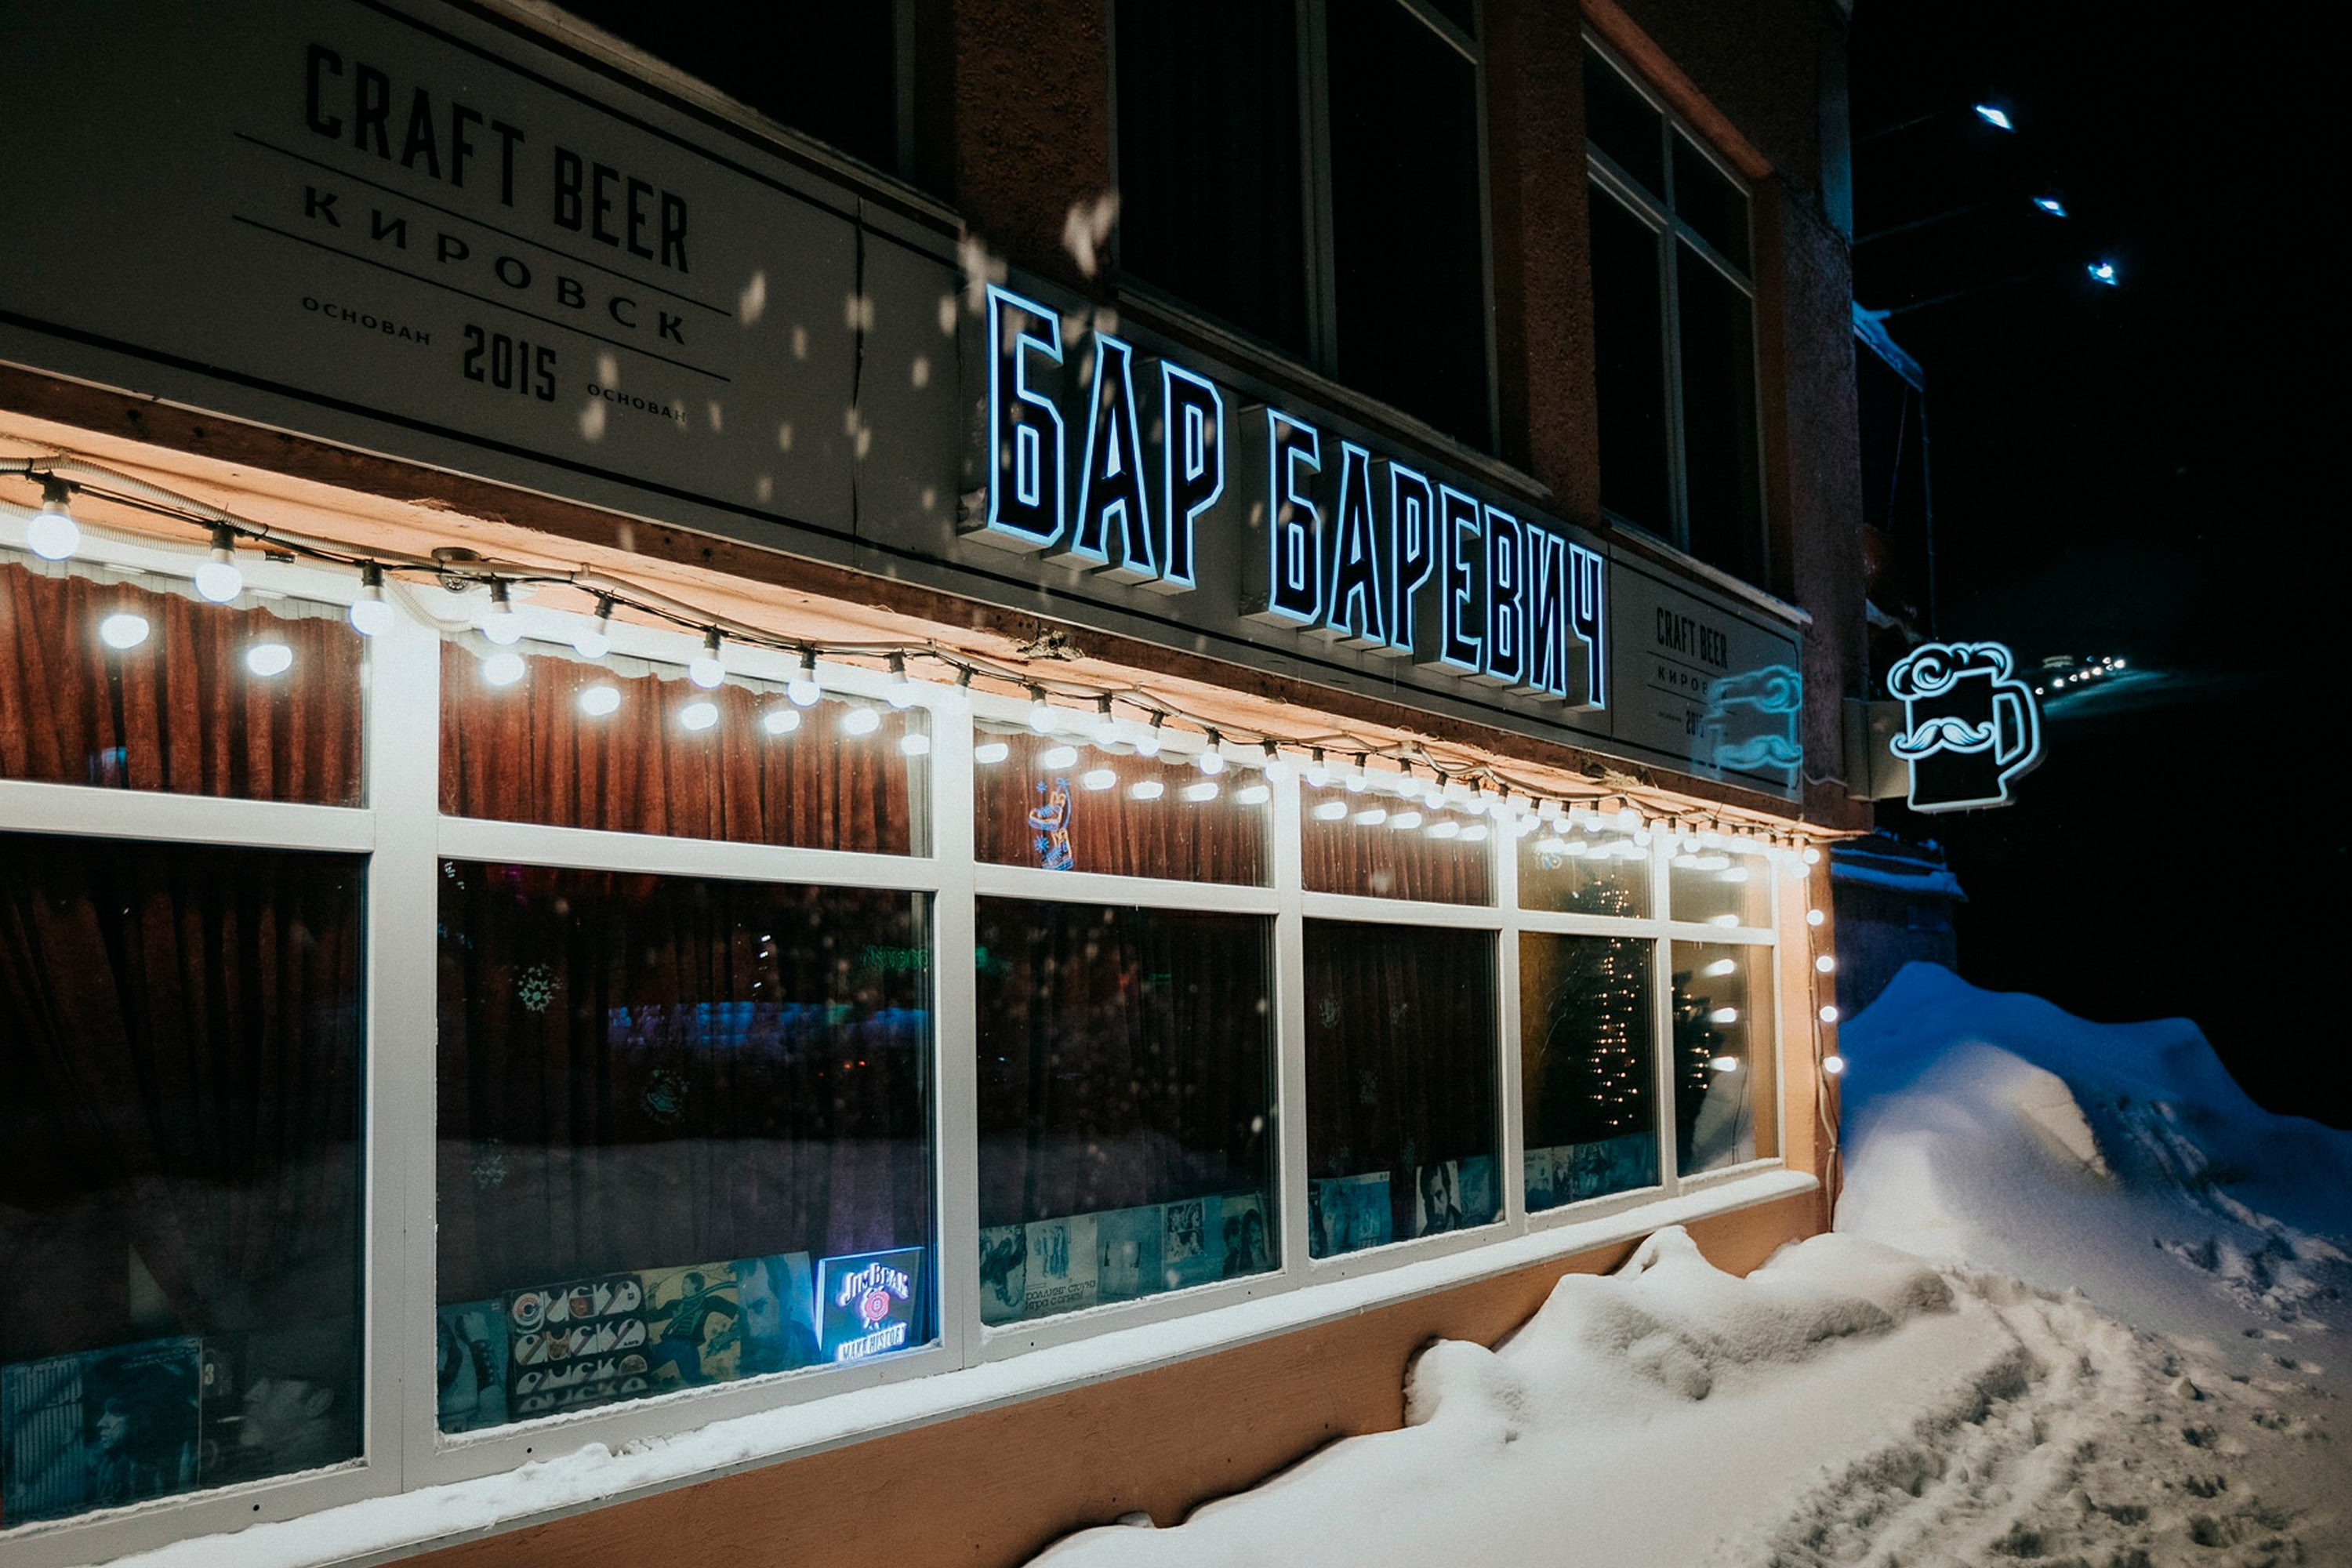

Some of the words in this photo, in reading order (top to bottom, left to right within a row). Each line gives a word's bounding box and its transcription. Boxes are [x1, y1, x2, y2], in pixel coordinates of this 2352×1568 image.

[306, 43, 525, 207] CRAFT
[554, 145, 689, 274] BEER
[304, 185, 686, 346] КИРОВСК
[302, 296, 431, 346] ОСНОВАН
[463, 323, 557, 403] 2015
[587, 383, 686, 423] ОСНОВАН
[986, 282, 1225, 590] БАР
[1266, 407, 1606, 710] БАРЕВИЧ
[1657, 606, 1695, 657] CRAFT
[1699, 625, 1728, 670] BEER
[1658, 666, 1727, 700] КИРОВ
